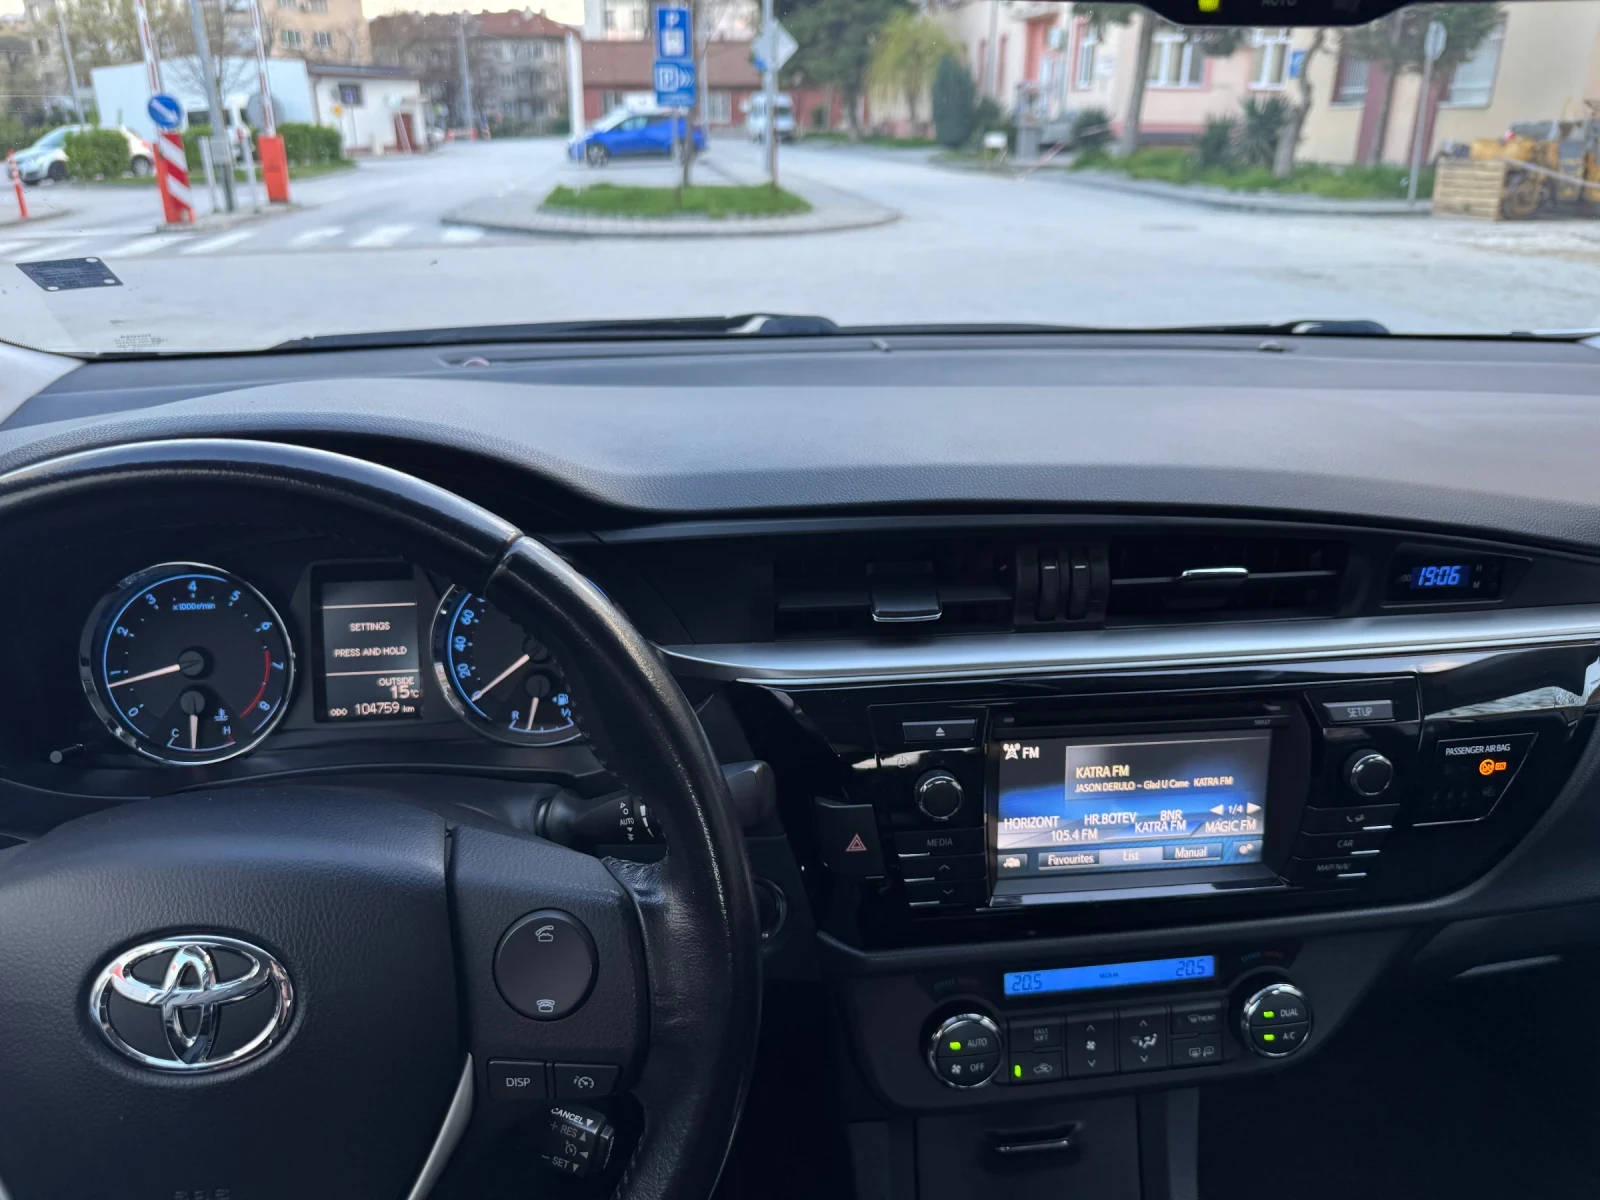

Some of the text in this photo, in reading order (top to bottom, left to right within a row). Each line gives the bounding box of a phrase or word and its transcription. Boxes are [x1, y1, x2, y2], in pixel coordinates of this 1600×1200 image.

[1418, 565, 1461, 586] 19:06
[187, 580, 198, 591] 4
[146, 593, 157, 605] 3
[230, 590, 241, 602] 5
[460, 609, 474, 625] 60
[116, 626, 128, 637] 2
[350, 622, 390, 632] SETTINGS
[454, 635, 466, 652] 40
[334, 646, 407, 658] PRESS AND HOLD
[457, 663, 471, 679] 20
[378, 676, 414, 687] OUTSIDE
[128, 707, 139, 718] 0
[329, 702, 416, 717] ODO 104759 km
[511, 710, 519, 720] R
[1347, 707, 1372, 717] SETUP
[171, 728, 180, 738] C
[222, 725, 231, 735] H
[1022, 747, 1040, 759] FM
[1445, 743, 1510, 756] PASSENGER AIR BAG
[1076, 765, 1130, 778] KATRA FM
[1075, 782, 1102, 793] JASON
[1102, 781, 1135, 792] DERULO
[1194, 777, 1219, 787] KATRA
[1219, 776, 1234, 786] FM
[1160, 810, 1183, 821] BNR
[1227, 805, 1243, 814] 1/4
[620, 817, 634, 826] AUTO
[1004, 816, 1060, 829] HORIZONT
[1135, 820, 1186, 833] KATRA FM
[1205, 819, 1257, 832] MAGIC FM
[1051, 828, 1098, 842] 105.4 FM
[926, 838, 954, 847] MEDIA
[1336, 839, 1354, 848] CAR
[1122, 851, 1139, 861] List
[1174, 846, 1207, 858] Manual
[1047, 854, 1094, 866] Favourites
[1176, 958, 1205, 977] 20.5
[1011, 973, 1042, 992] 20.5
[1280, 1008, 1299, 1017] DUAL
[967, 1038, 987, 1047] AUTO
[970, 1063, 984, 1072] OFF
[506, 1077, 531, 1087] DISP
[551, 1107, 584, 1125] CANCEL
[560, 1124, 578, 1138] RES
[552, 1156, 570, 1169] SET
